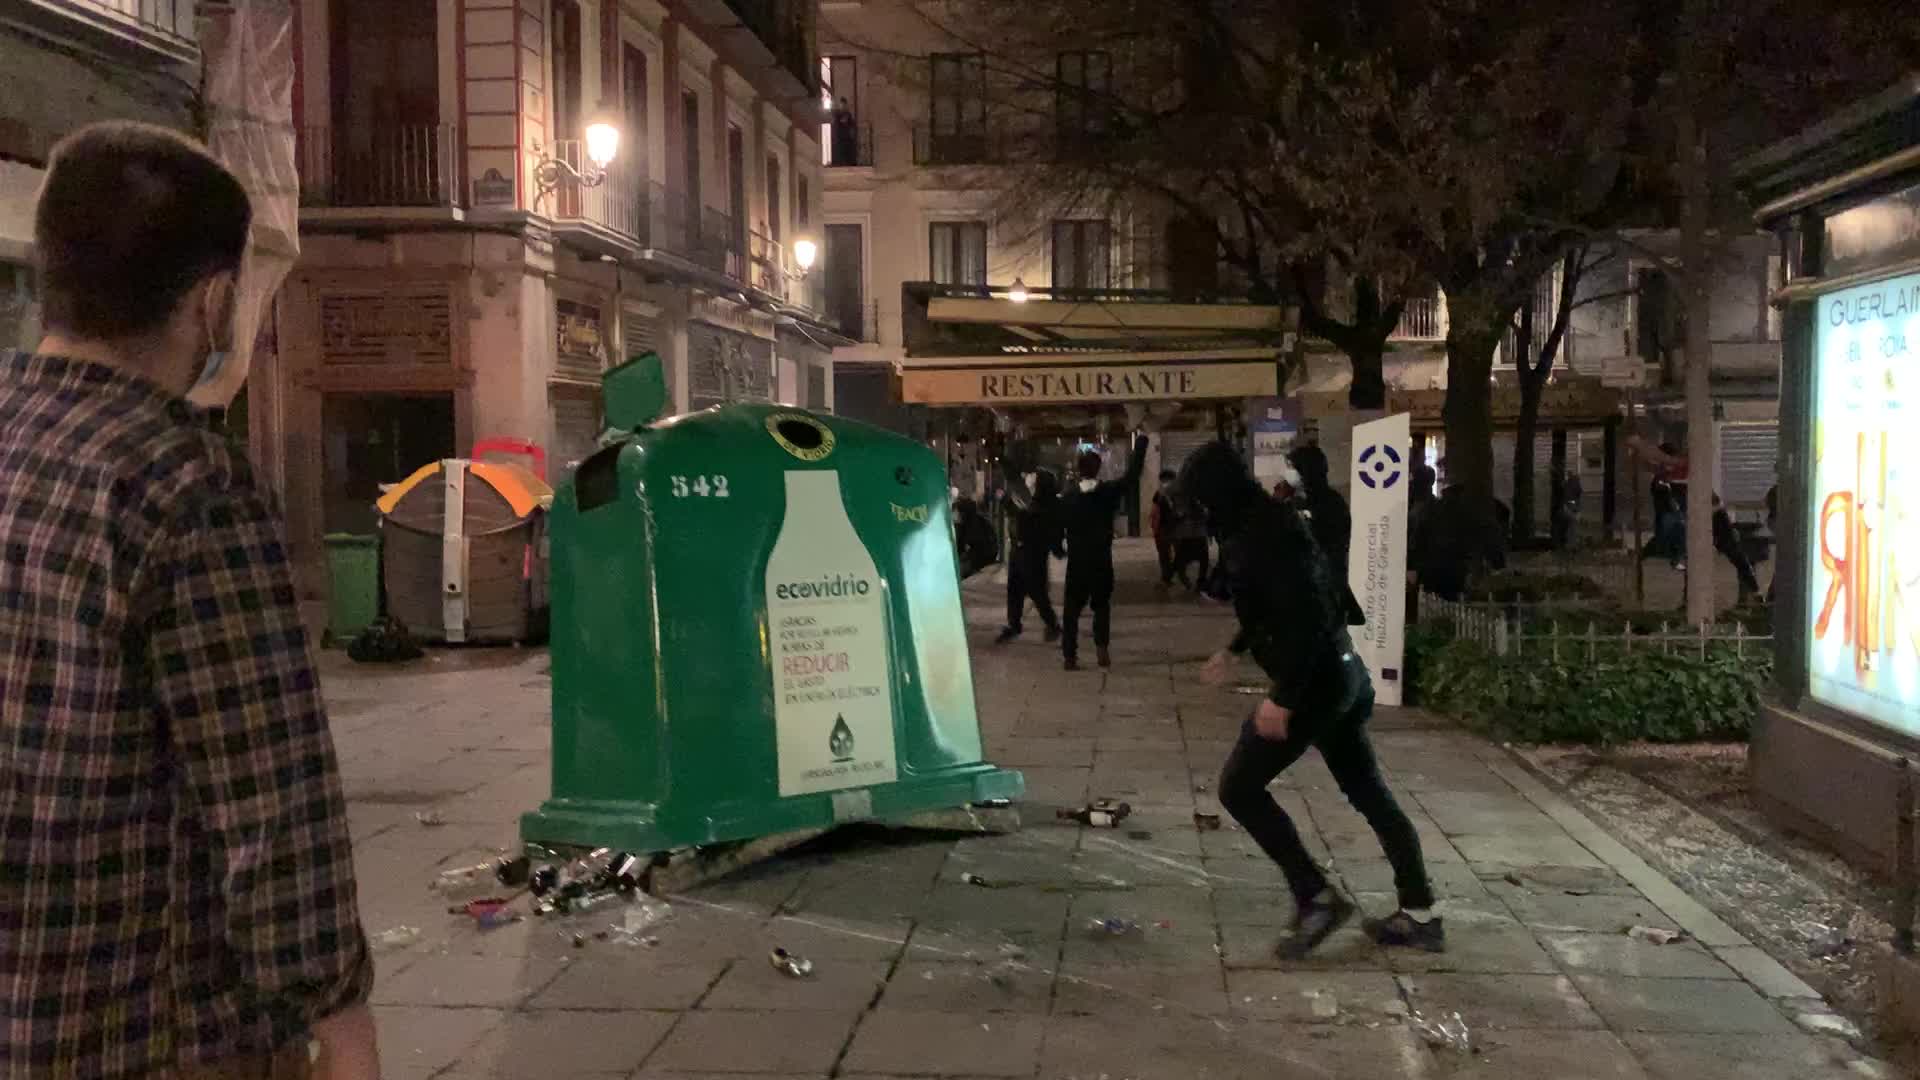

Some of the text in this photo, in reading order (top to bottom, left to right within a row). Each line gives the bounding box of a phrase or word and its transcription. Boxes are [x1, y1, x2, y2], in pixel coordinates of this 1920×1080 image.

[980, 370, 1196, 398] RESTAURANTE
[670, 474, 730, 498] 542
[1377, 515, 1390, 569] Granada
[775, 573, 869, 600] ecovidrio
[1364, 523, 1378, 641] Centro Comercial
[1377, 575, 1388, 589] de
[784, 652, 850, 675] REDUCIR
